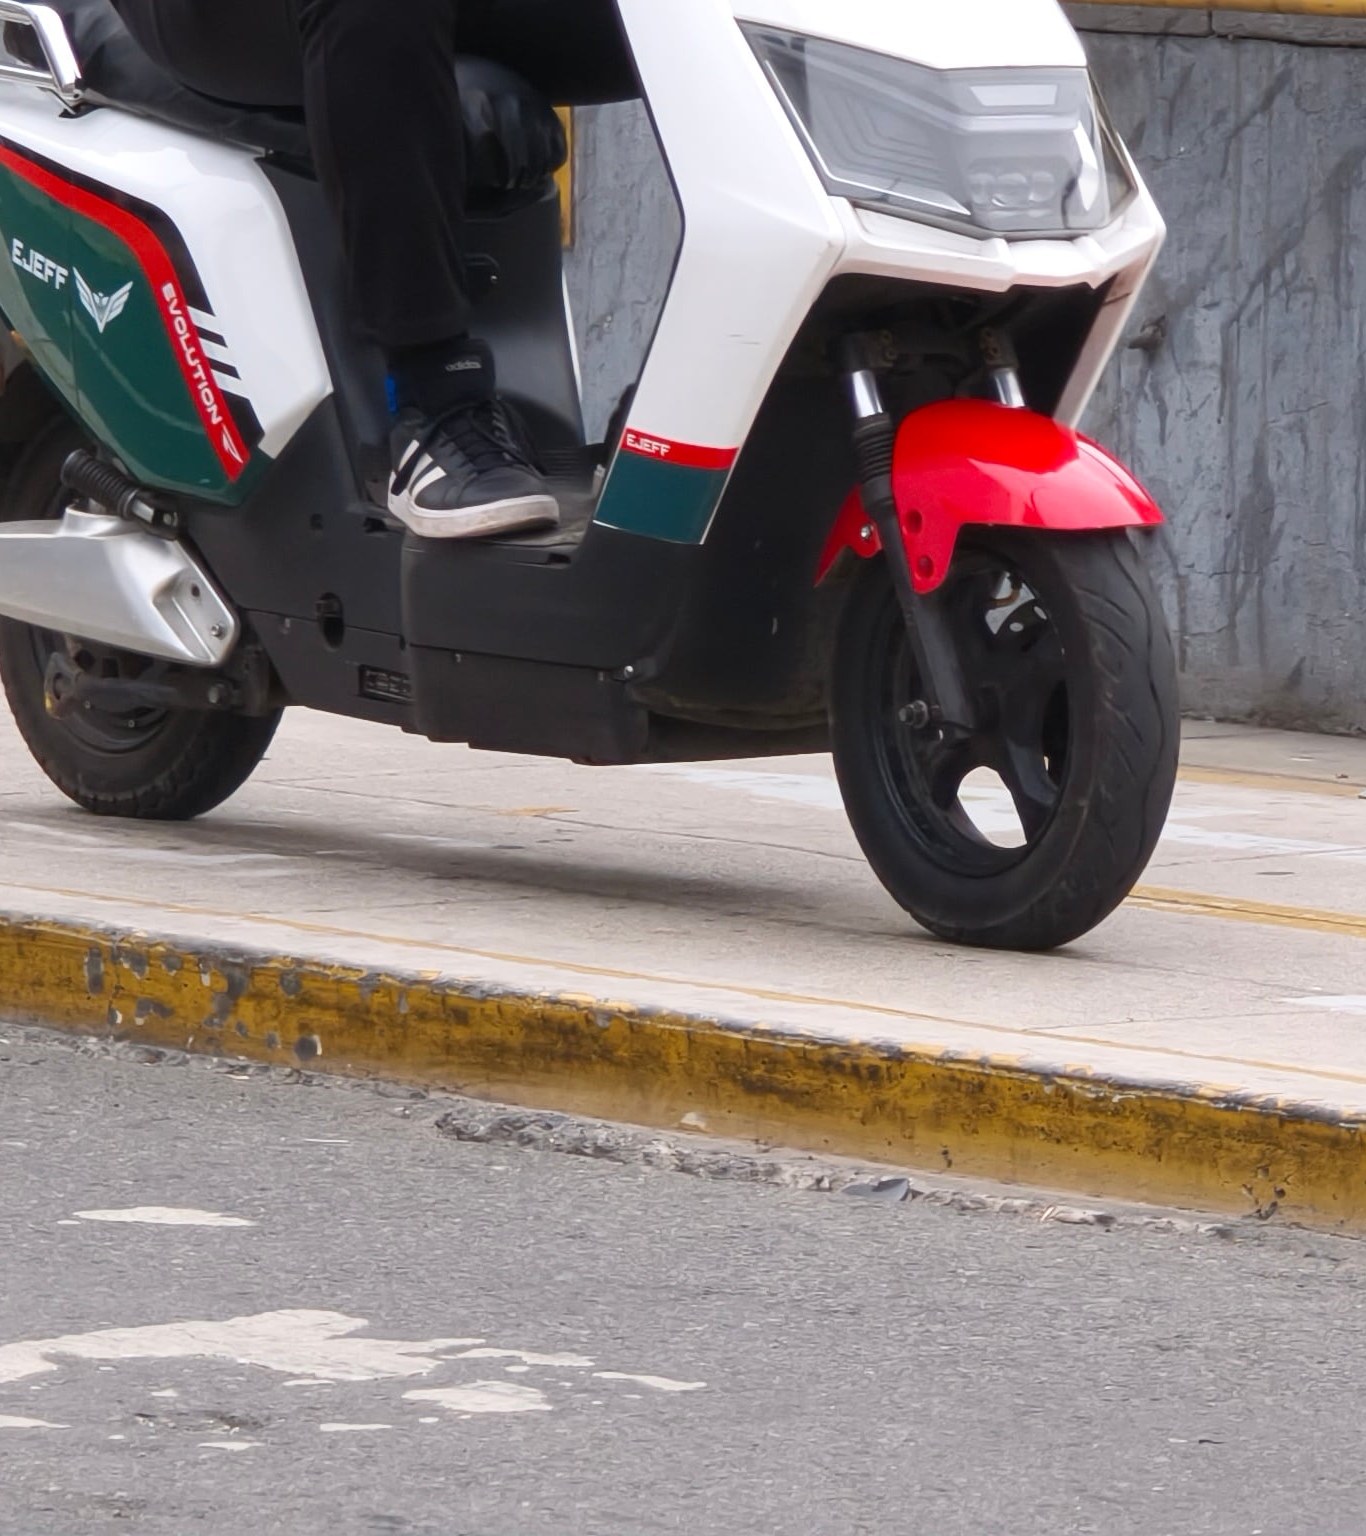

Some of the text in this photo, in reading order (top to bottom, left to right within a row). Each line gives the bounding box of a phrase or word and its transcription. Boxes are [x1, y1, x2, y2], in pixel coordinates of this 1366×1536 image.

[12, 238, 69, 290] EJEFF
[161, 282, 223, 425] EVOLUTION
[626, 433, 671, 456] EJEFF
